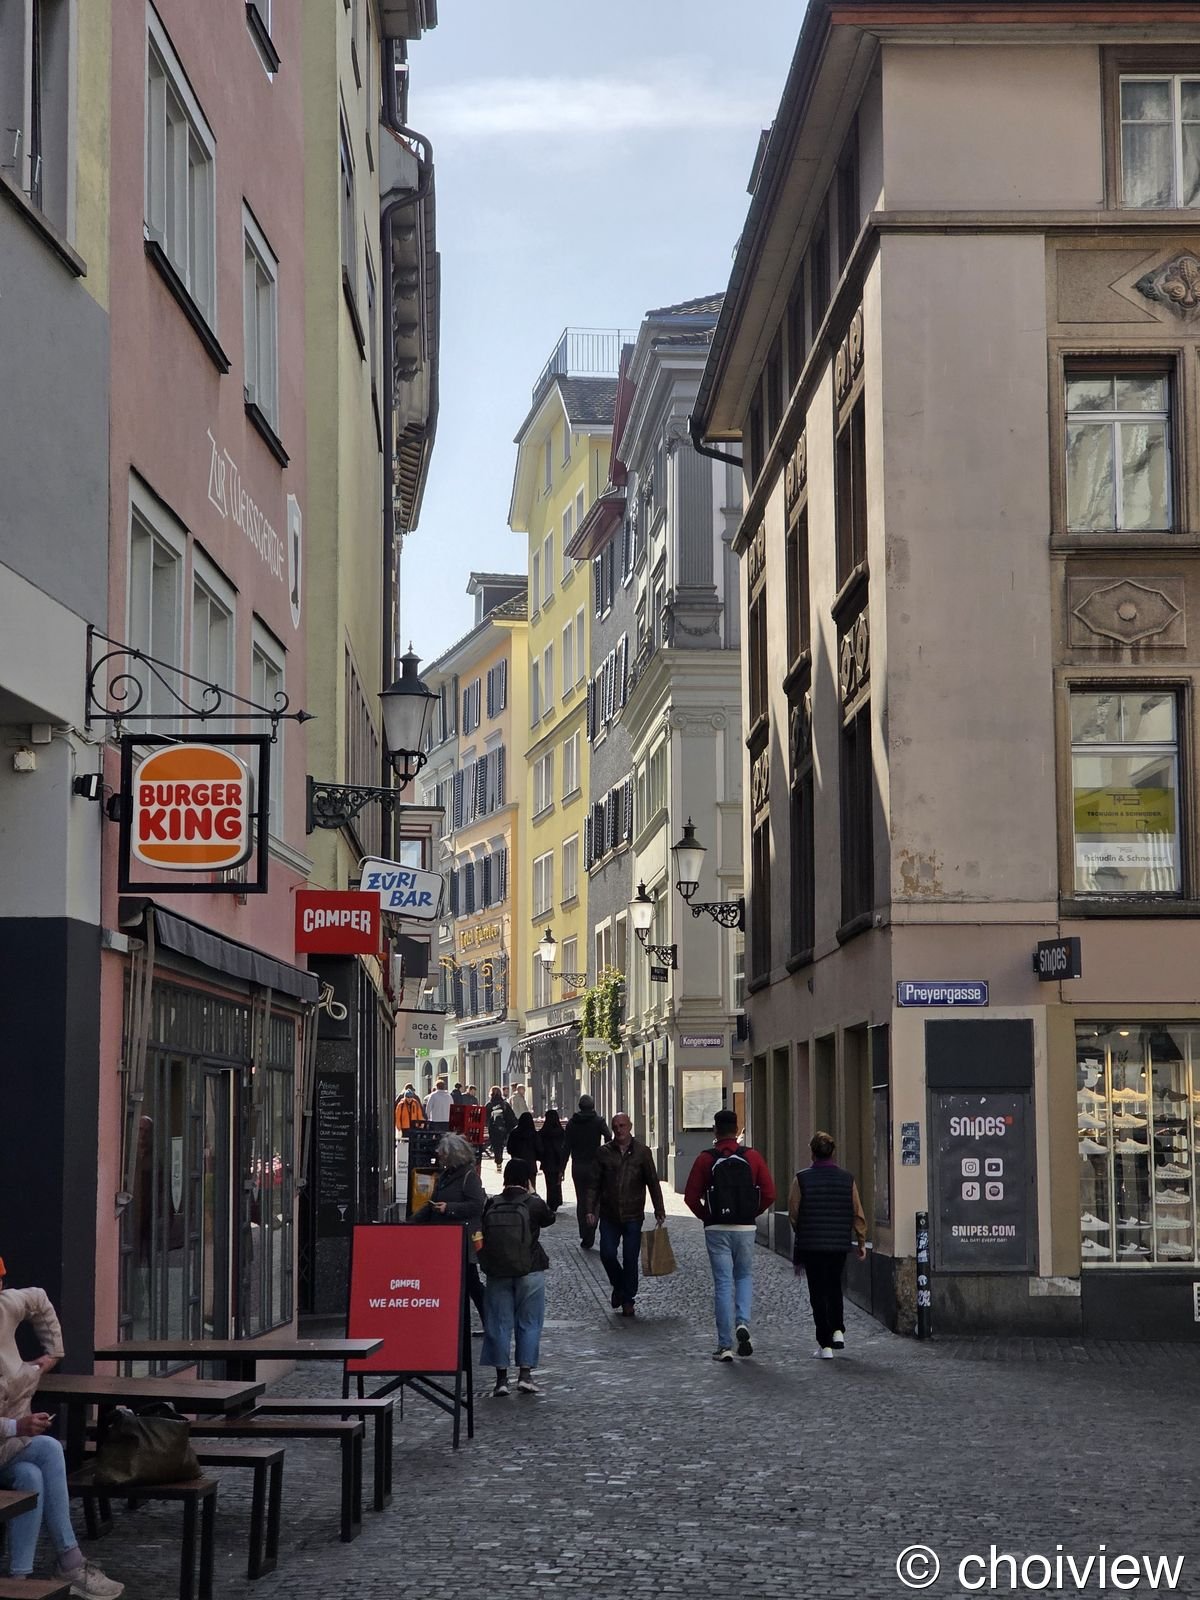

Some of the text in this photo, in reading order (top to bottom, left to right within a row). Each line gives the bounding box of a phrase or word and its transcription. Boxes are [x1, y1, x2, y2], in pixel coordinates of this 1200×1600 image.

[139, 783, 243, 807] BURGER
[139, 807, 243, 841] KING
[1118, 854, 1125, 862] &
[388, 890, 434, 907] BAR
[303, 908, 371, 935] CAMPER
[1039, 946, 1067, 975] snipes
[905, 984, 981, 1004] Preyergasse
[411, 1023, 438, 1031] ace &
[419, 1031, 438, 1041] tate
[950, 1116, 1006, 1140] snipes
[951, 1225, 1016, 1237] SNIPES.COM
[390, 1279, 420, 1290] CAMPER
[369, 1298, 440, 1308] WE ARE OPEN
